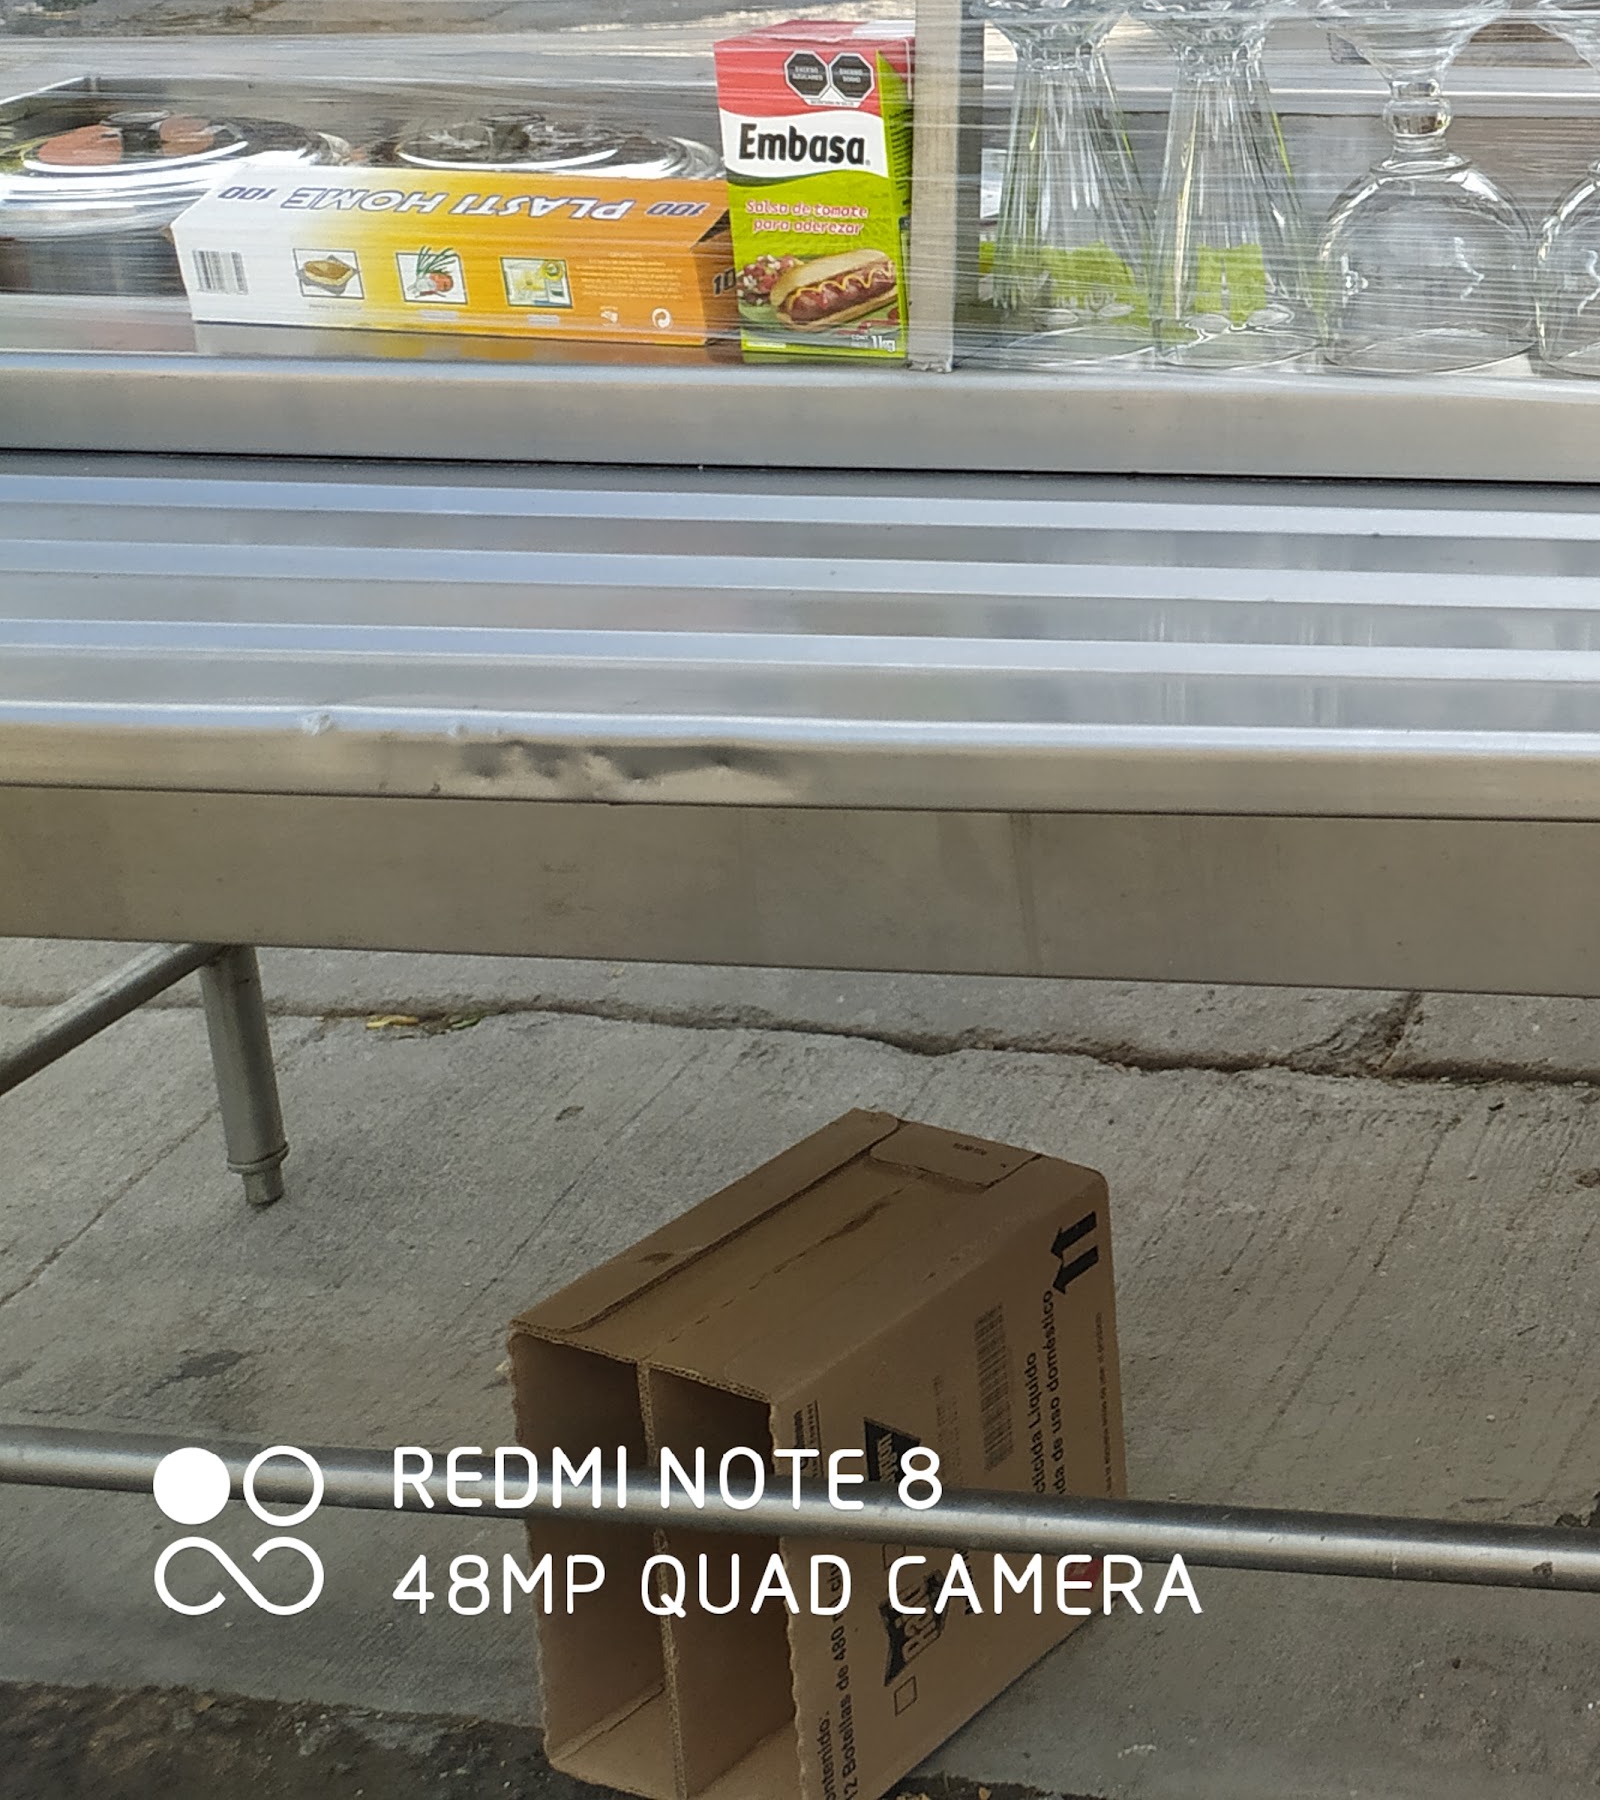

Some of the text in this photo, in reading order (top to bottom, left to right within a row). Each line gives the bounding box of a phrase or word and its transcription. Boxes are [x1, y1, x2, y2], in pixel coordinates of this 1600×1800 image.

[738, 123, 866, 165] Embasa
[218, 186, 710, 221] 100 PLASTI HOME 100
[746, 200, 868, 219] Salsa de tomate
[753, 218, 864, 235] para aderezar
[1023, 1352, 1044, 1426] Líquido
[1038, 1290, 1065, 1462] de uso doméstico
[830, 1626, 857, 1777] Botellas de 480
[817, 1711, 837, 1800] ontenido:
